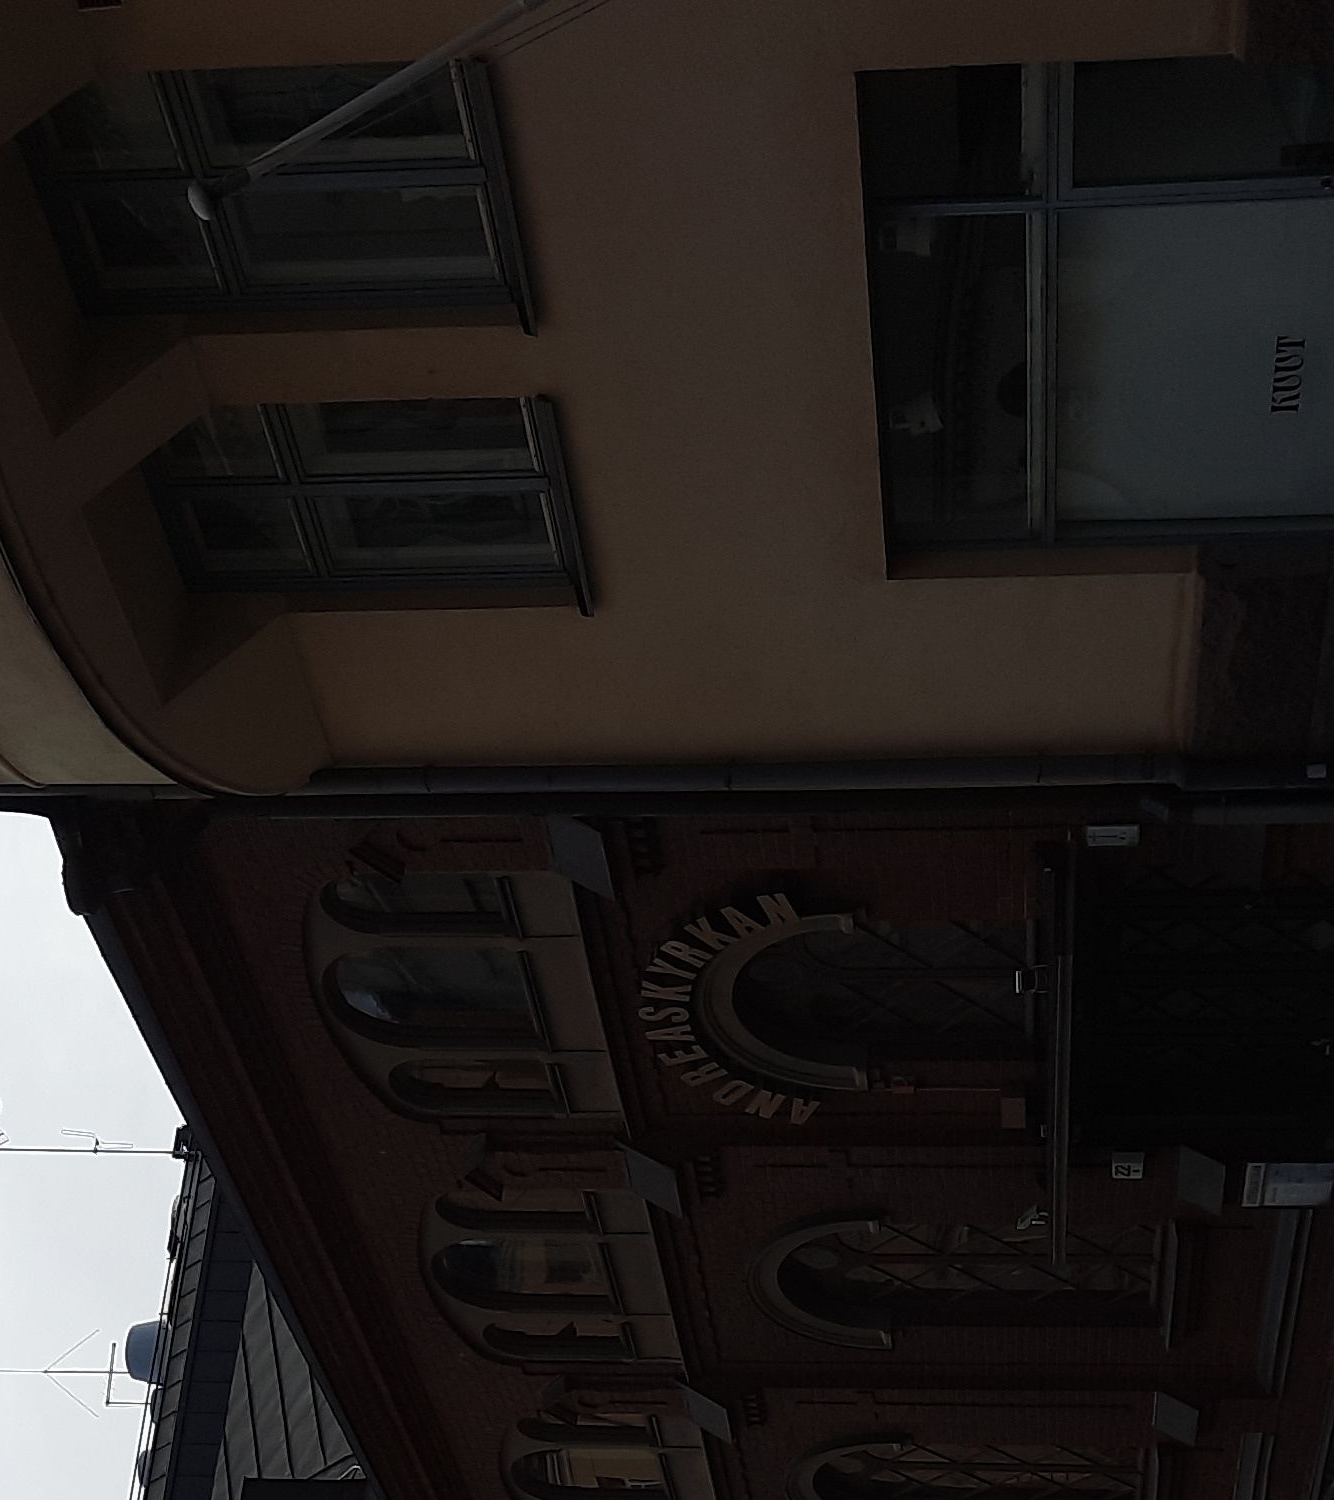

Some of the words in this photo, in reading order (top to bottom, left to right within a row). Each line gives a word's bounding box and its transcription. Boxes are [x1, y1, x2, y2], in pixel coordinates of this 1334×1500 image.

[1270, 336, 1306, 413] KUUT
[637, 892, 821, 1125] ANDREASKYRKAN
[1114, 1164, 1131, 1177] 22
